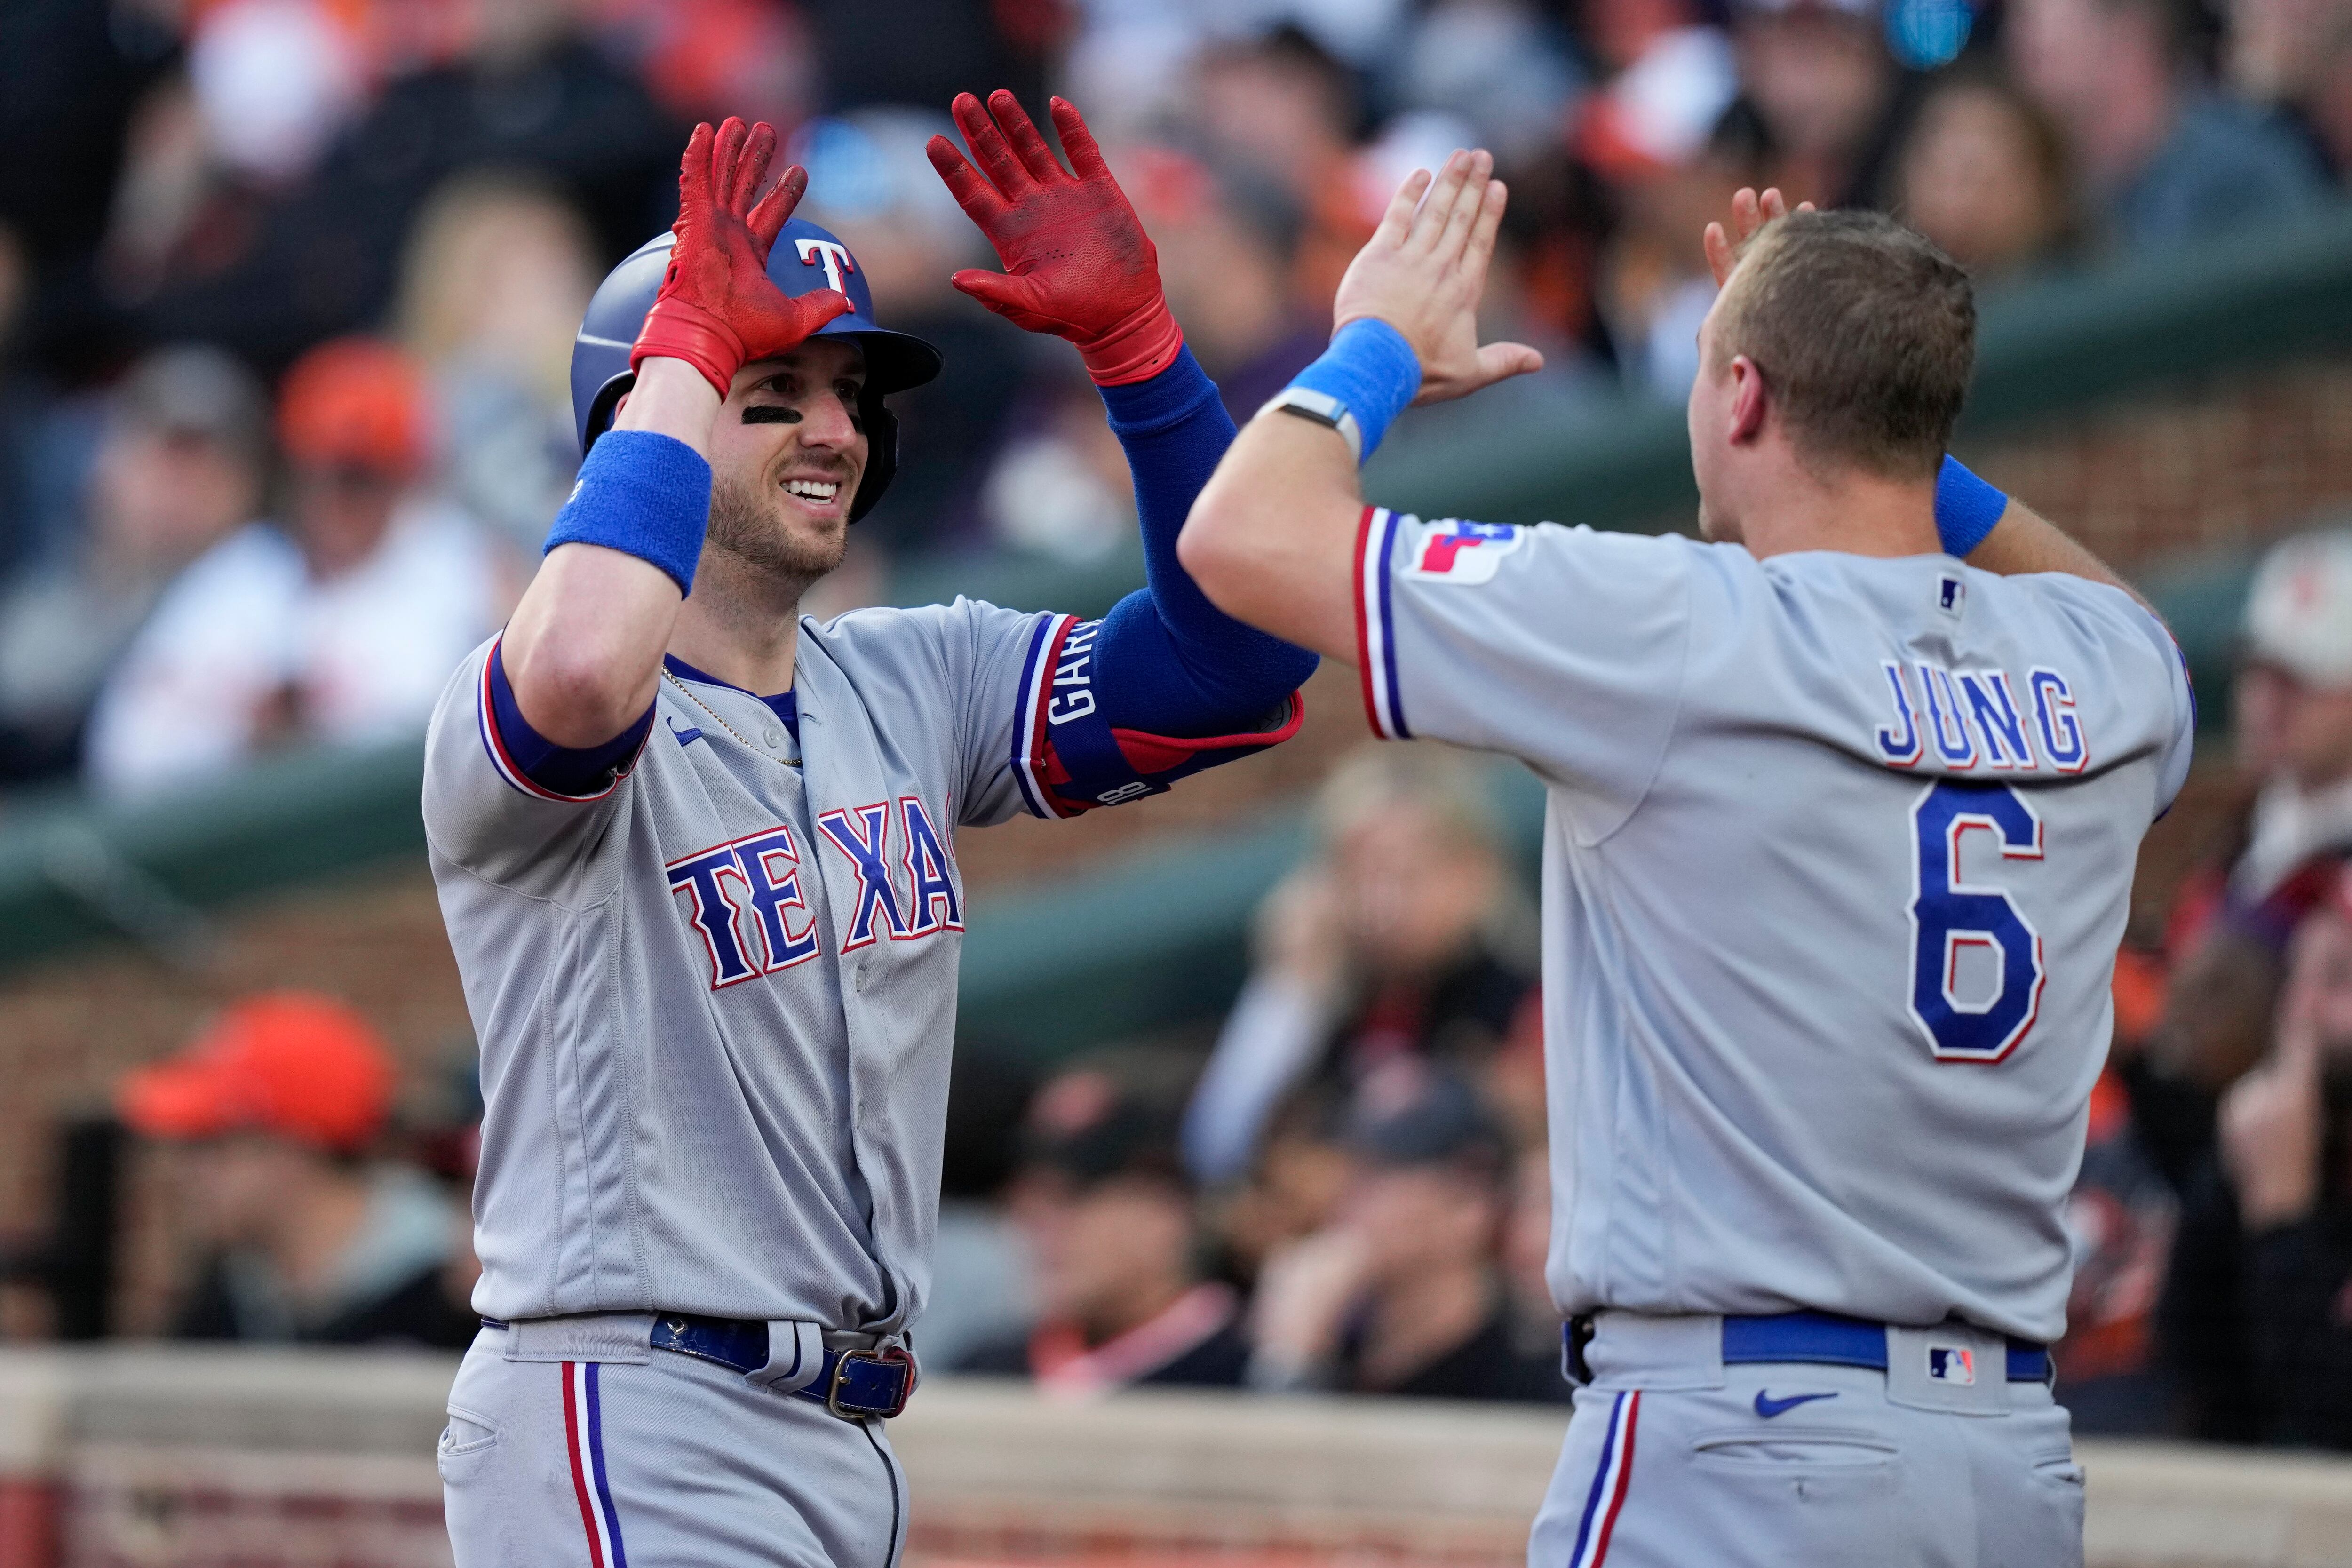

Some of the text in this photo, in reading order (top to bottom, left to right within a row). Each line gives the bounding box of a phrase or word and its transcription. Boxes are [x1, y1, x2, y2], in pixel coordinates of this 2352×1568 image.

[794, 239, 855, 313] T
[1048, 618, 1106, 725] GARV
[1874, 659, 2090, 774] JUNG
[1097, 781, 1153, 805] 18
[665, 792, 965, 991] TEXA
[1905, 779, 2047, 1064] 6
